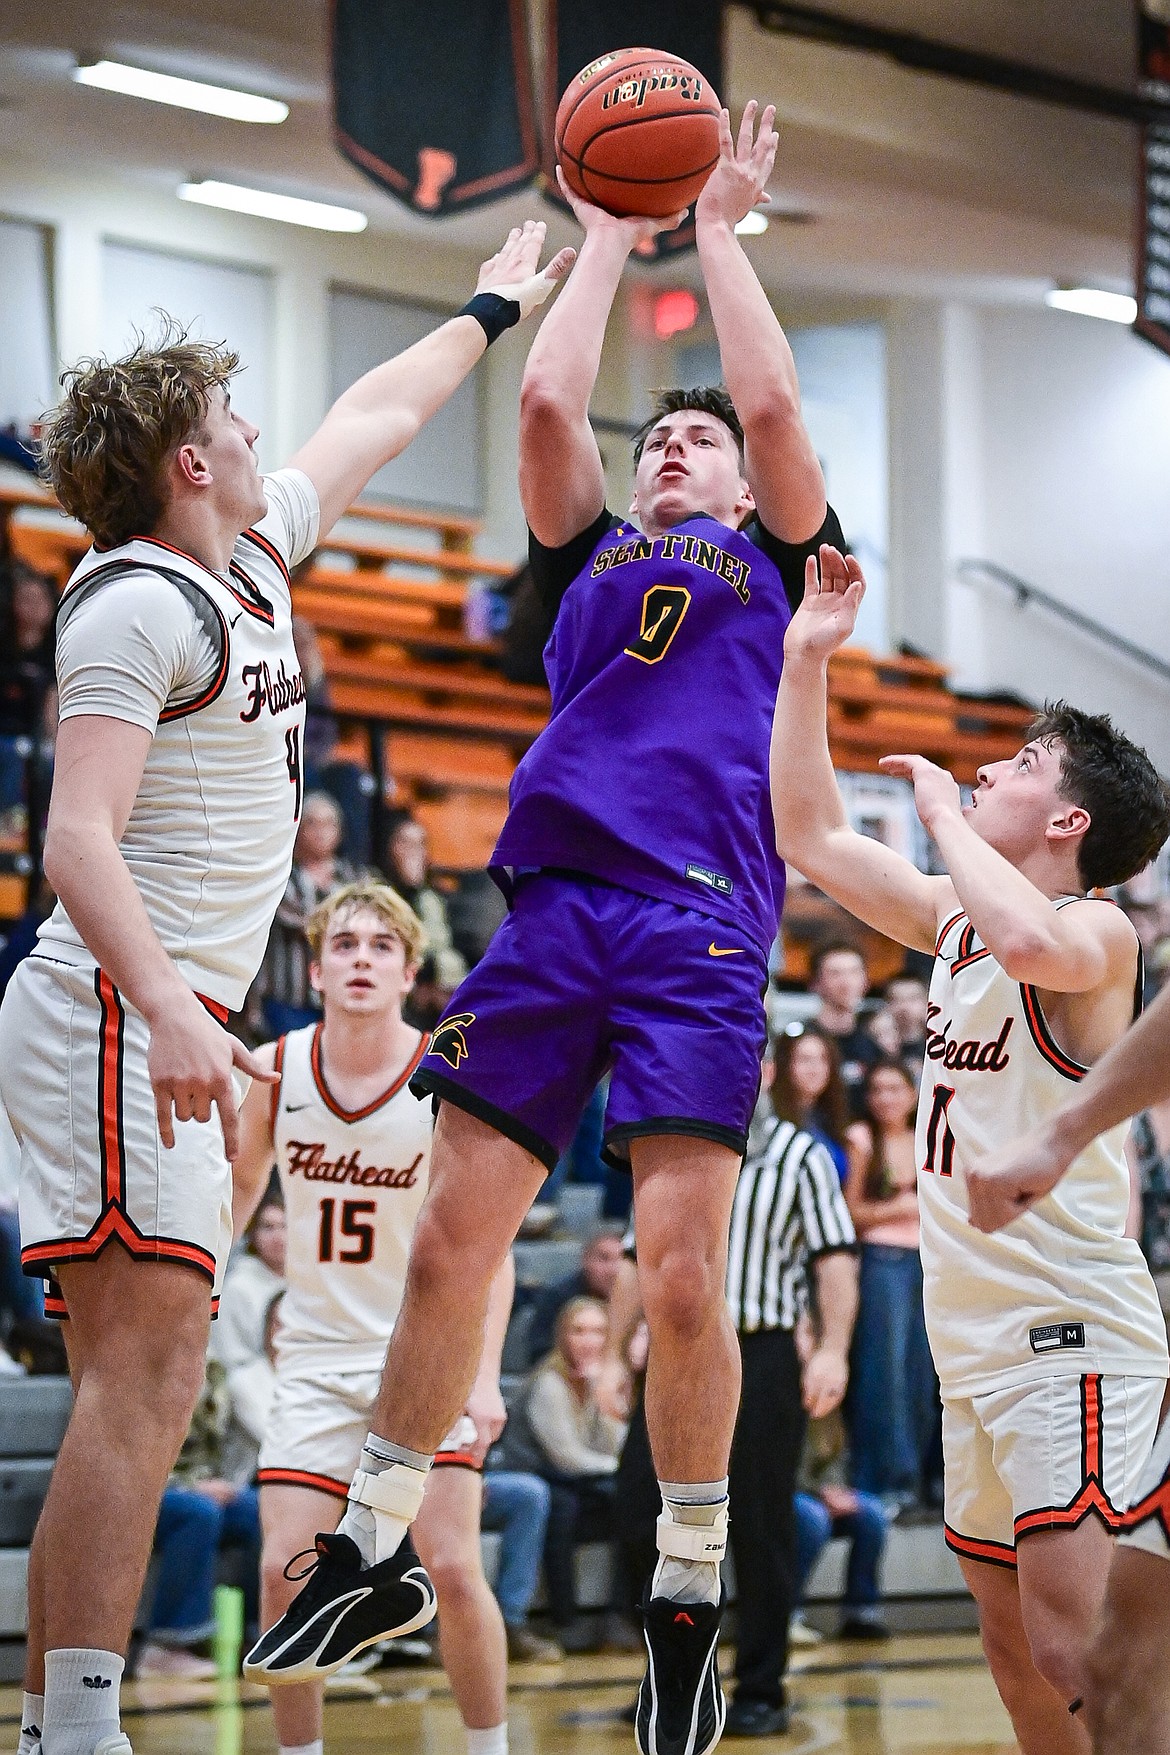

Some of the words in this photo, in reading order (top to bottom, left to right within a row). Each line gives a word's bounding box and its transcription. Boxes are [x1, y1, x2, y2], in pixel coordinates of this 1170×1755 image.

[602, 74, 702, 110] Baden
[591, 535, 751, 605] SENTINEL
[624, 585, 692, 665] 0
[285, 724, 301, 822] 4
[717, 879, 728, 889] XL
[286, 1139, 424, 1189] Flathead
[317, 1197, 378, 1264] 15
[1066, 1329, 1077, 1340] M
